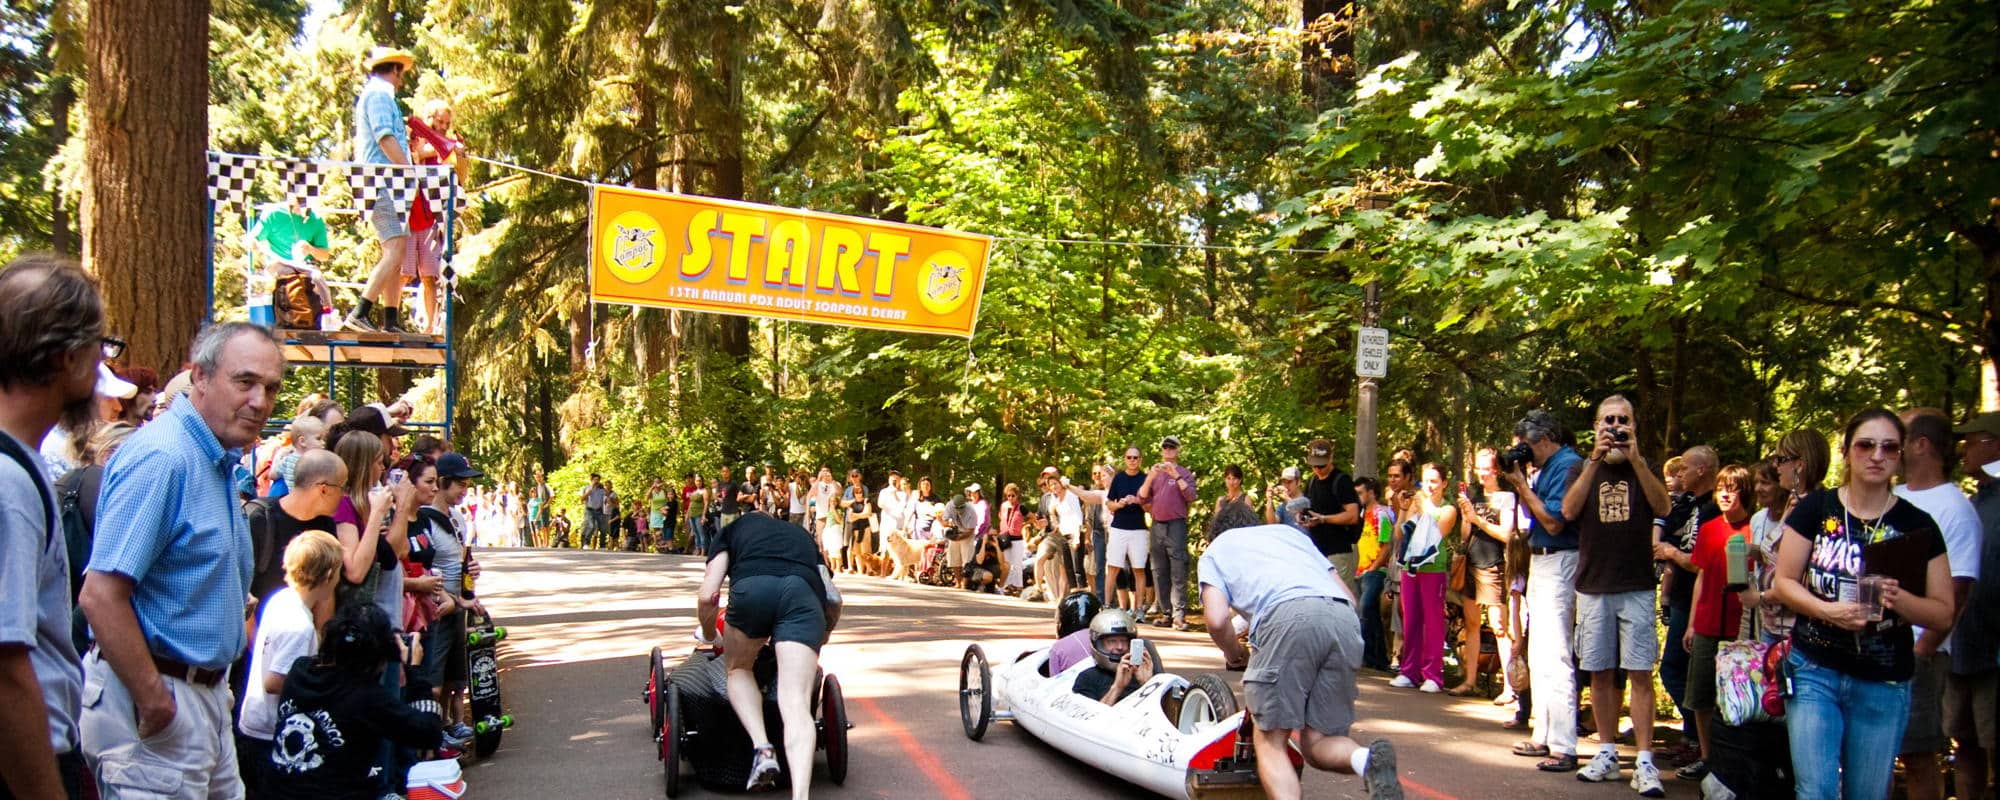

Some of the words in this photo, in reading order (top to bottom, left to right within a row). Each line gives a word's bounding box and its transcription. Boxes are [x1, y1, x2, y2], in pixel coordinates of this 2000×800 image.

[679, 209, 912, 301] START
[669, 286, 699, 299] 13TH
[702, 288, 747, 304] ANNUAL
[749, 293, 774, 306] PDX
[776, 297, 812, 311] ADULT
[815, 301, 868, 316] SOAPBOX
[870, 306, 908, 319] DERBY
[1362, 348, 1382, 358] VEHICLES
[1363, 360, 1380, 370] ONLY
